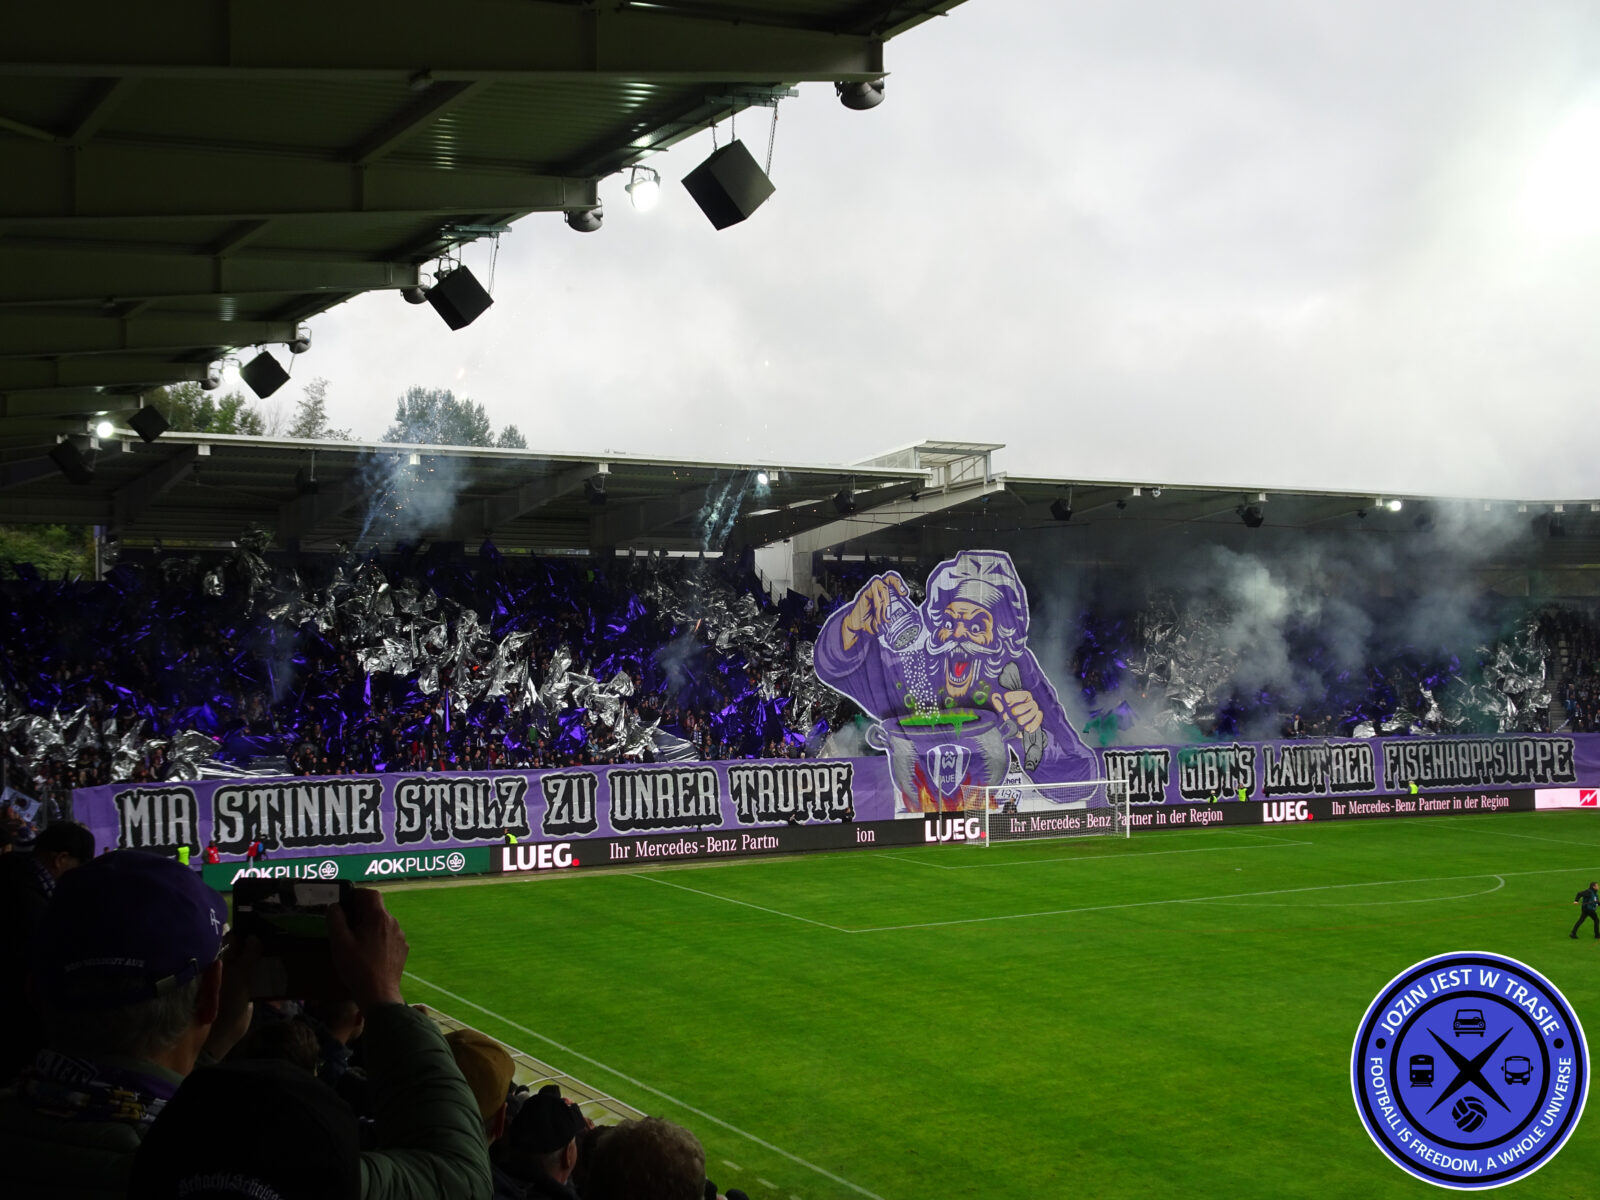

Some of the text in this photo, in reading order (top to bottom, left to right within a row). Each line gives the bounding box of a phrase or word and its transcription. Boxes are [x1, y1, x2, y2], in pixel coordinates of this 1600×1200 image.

[1107, 753, 1166, 797] HEIT
[400, 781, 524, 833] STOLZ
[547, 777, 593, 825] ZU
[731, 766, 849, 814] TRUPPE
[1332, 801, 1346, 815] Ihr
[1419, 796, 1450, 812] Partner
[1453, 796, 1462, 809] in
[1464, 795, 1479, 809] der
[1481, 794, 1509, 812] Region
[1156, 810, 1166, 824] in
[1170, 809, 1186, 823] der
[1190, 808, 1223, 826] Region
[609, 842, 629, 860] Ihr
